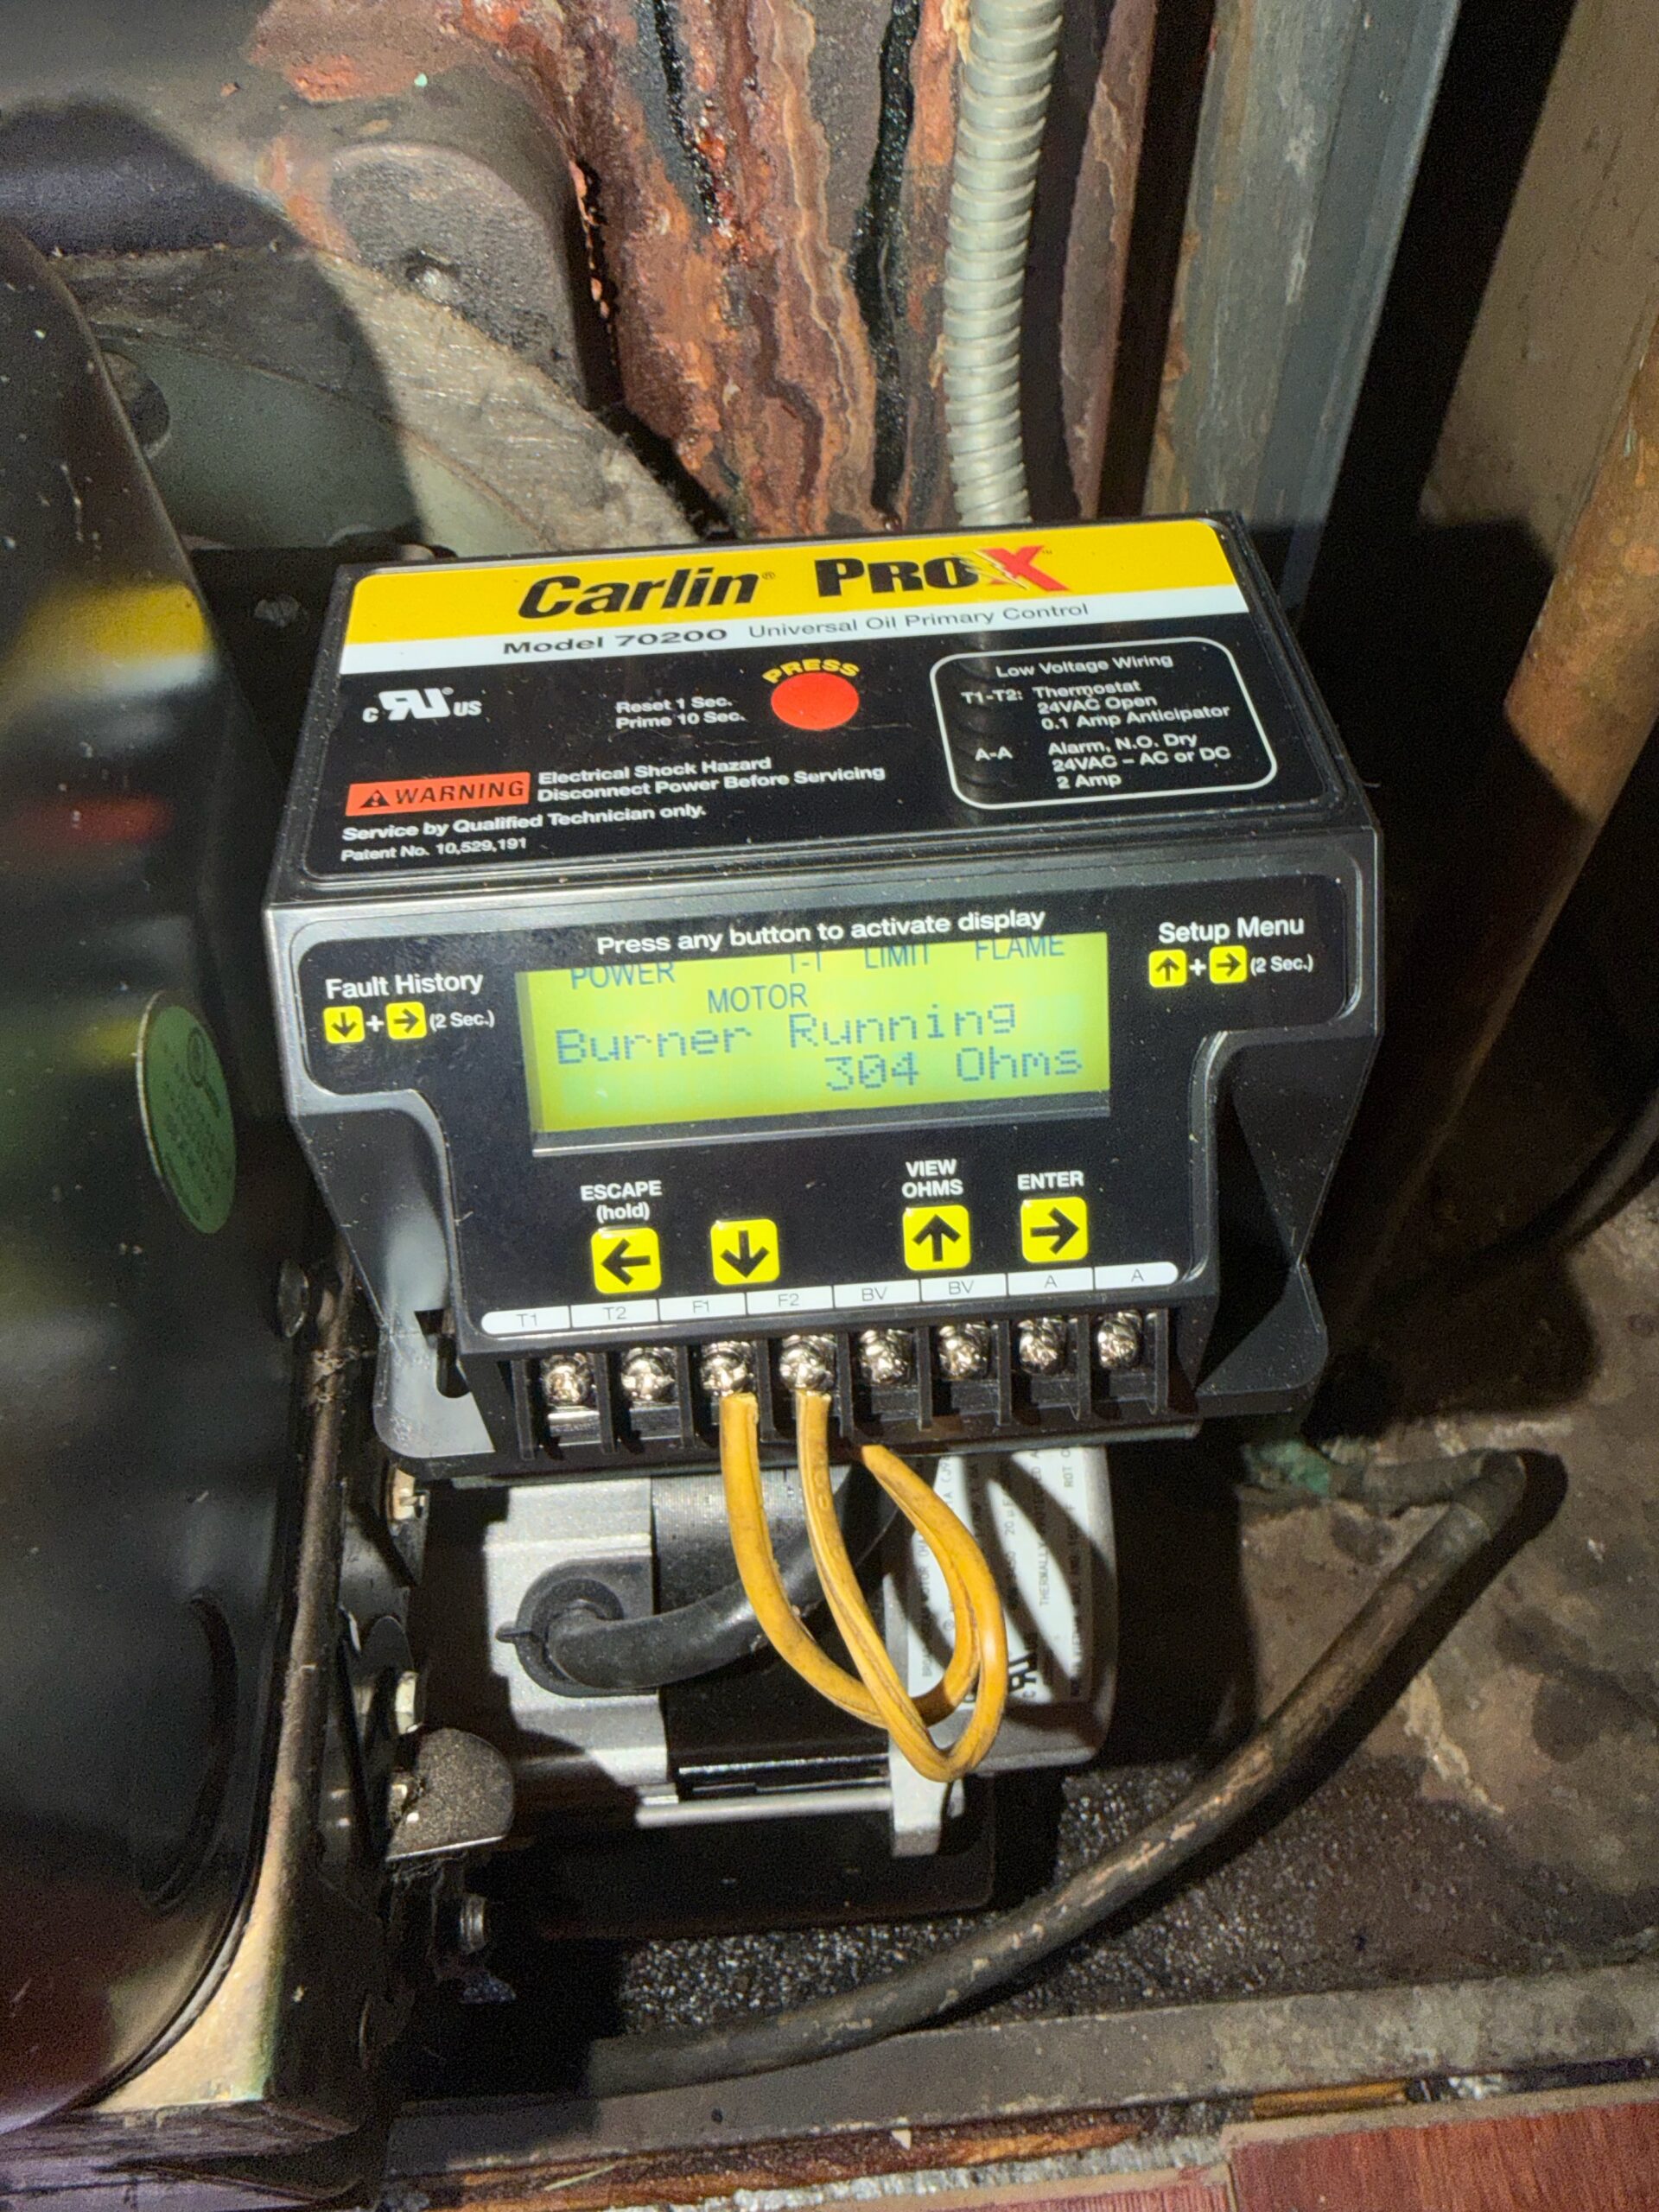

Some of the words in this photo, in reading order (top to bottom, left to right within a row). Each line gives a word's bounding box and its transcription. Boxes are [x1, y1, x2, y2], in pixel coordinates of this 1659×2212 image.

[503, 636, 603, 654] Model
[616, 628, 728, 647] 70200
[748, 619, 858, 639] Universal
[866, 614, 898, 631] Oil
[904, 608, 995, 632] Primary
[1002, 603, 1090, 622] Control
[762, 658, 860, 683] PRESS
[995, 664, 1035, 678] Low
[1039, 658, 1109, 676] Voltage
[1113, 653, 1173, 670] Wiring
[961, 689, 1024, 704] T1-T2:
[1033, 679, 1142, 699] Thermostat
[1037, 697, 1101, 715] 24VAC
[1104, 694, 1158, 710] Open
[615, 699, 671, 714] Reset
[677, 699, 684, 709] 1
[690, 696, 733, 709] Sec.
[1041, 716, 1069, 731] 0.1
[1076, 713, 1122, 730] Amp
[1126, 705, 1231, 726] Anticipator
[615, 715, 672, 730] Prime
[678, 713, 699, 725] 10
[702, 710, 746, 724] Sec.
[975, 747, 1014, 761] A-A
[1047, 740, 1112, 757] Alarm,
[1115, 735, 1160, 751] N.O.
[1163, 732, 1198, 749] Dry
[1052, 753, 1118, 772] 24VAC
[1139, 751, 1170, 766] AC
[1174, 750, 1196, 763] or
[1199, 746, 1232, 761] DC
[538, 766, 629, 785] Electrical
[634, 762, 696, 779] Shock
[701, 756, 772, 774] Hazard
[1056, 775, 1071, 790] 2
[1075, 772, 1122, 790] Amp
[395, 780, 524, 805] WARNING
[537, 783, 650, 803] Disconnect
[654, 779, 720, 795] Power
[723, 773, 790, 790] Before
[793, 766, 887, 786] Servicing
[341, 823, 419, 842] Service
[423, 822, 450, 837] by
[453, 814, 543, 835] Qualified
[547, 807, 655, 826] Technician
[659, 804, 707, 821] only.
[340, 846, 397, 862] Patent
[400, 844, 430, 858] No.
[435, 836, 527, 855] 10,529,191
[597, 935, 671, 955] Press
[677, 931, 724, 952] any
[729, 926, 811, 947] button
[818, 923, 844, 941] to
[850, 912, 951, 939] activate
[957, 909, 1046, 932] display
[1158, 921, 1230, 944] Setup
[1236, 916, 1305, 938] Menu
[570, 961, 676, 989] POWER
[864, 942, 931, 969] LIMIT
[975, 936, 1065, 962] FLAME
[325, 976, 390, 1000] Fault
[394, 972, 484, 995] History
[707, 982, 809, 1014] MOTOR
[556, 1028, 752, 1065] Burner
[789, 1003, 1015, 1049] Running
[824, 1051, 919, 1091] 304
[956, 1046, 1083, 1082] Ohms
[906, 1158, 957, 1178] VIEW
[1017, 1170, 1084, 1191] ENTER
[580, 1179, 663, 1202] ESCAPE
[901, 1179, 963, 1199] OHMS
[596, 1201, 650, 1224] (hold)
[516, 1313, 537, 1327] T1
[602, 1306, 627, 1321] T2
[692, 1300, 710, 1314] F1
[778, 1292, 800, 1307] F2
[861, 1286, 888, 1302] BV
[948, 1280, 975, 1295] BV
[1044, 1274, 1058, 1289] A
[1129, 1268, 1145, 1283] A
